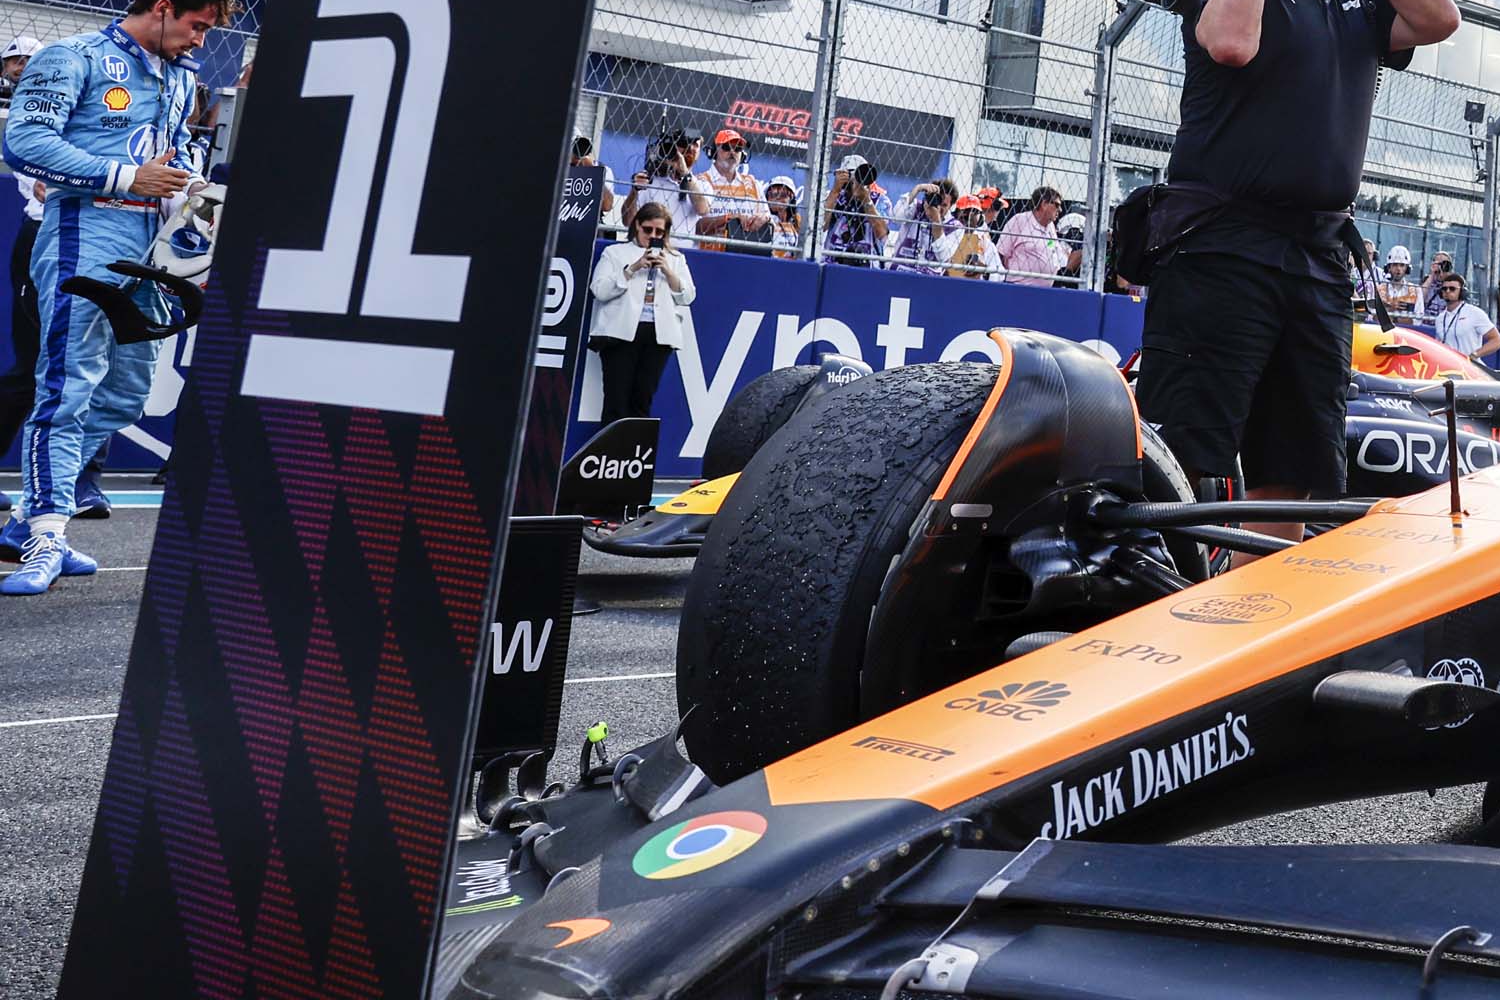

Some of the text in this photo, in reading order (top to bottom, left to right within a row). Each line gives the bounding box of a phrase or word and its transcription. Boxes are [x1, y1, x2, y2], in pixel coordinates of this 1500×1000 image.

[106, 55, 124, 81] hp
[102, 122, 128, 130] POKER
[725, 99, 863, 147] KNUCES
[765, 136, 809, 149] NOW STREAM
[558, 199, 594, 222] ami
[1374, 397, 1413, 413] ROKT
[579, 454, 643, 480] Claro
[1282, 555, 1397, 575] webex
[1189, 607, 1257, 620] Galicia
[1203, 599, 1275, 613] Estrella
[1068, 638, 1183, 666] FxPro
[944, 697, 1046, 722] CNBC
[850, 736, 956, 762] PIRELLI
[1041, 769, 1124, 841] JACK
